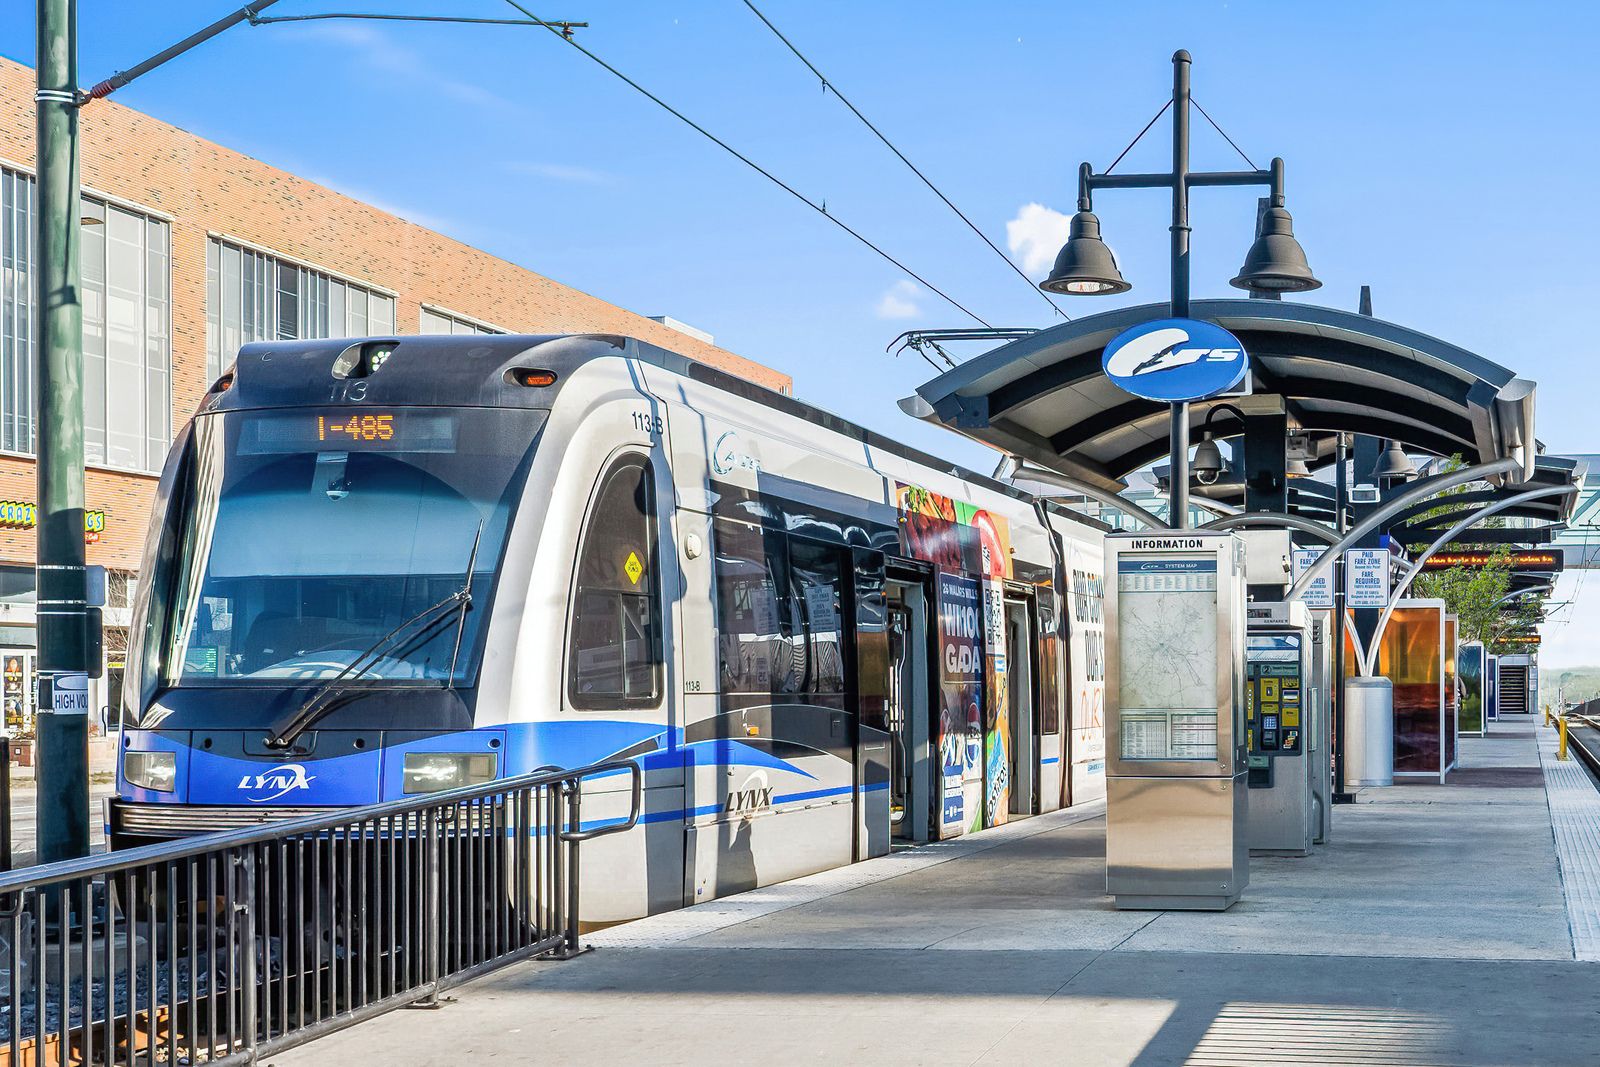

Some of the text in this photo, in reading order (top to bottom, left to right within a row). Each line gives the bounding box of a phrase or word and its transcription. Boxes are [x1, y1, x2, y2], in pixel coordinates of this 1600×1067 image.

[318, 415, 394, 440] I-485
[632, 411, 664, 435] 113-B
[1131, 539, 1203, 549] INFORMATION
[685, 681, 701, 691] 113-B
[55, 694, 88, 710] HIGH VO
[238, 767, 317, 791] LYNX
[726, 787, 774, 813] LYNX
